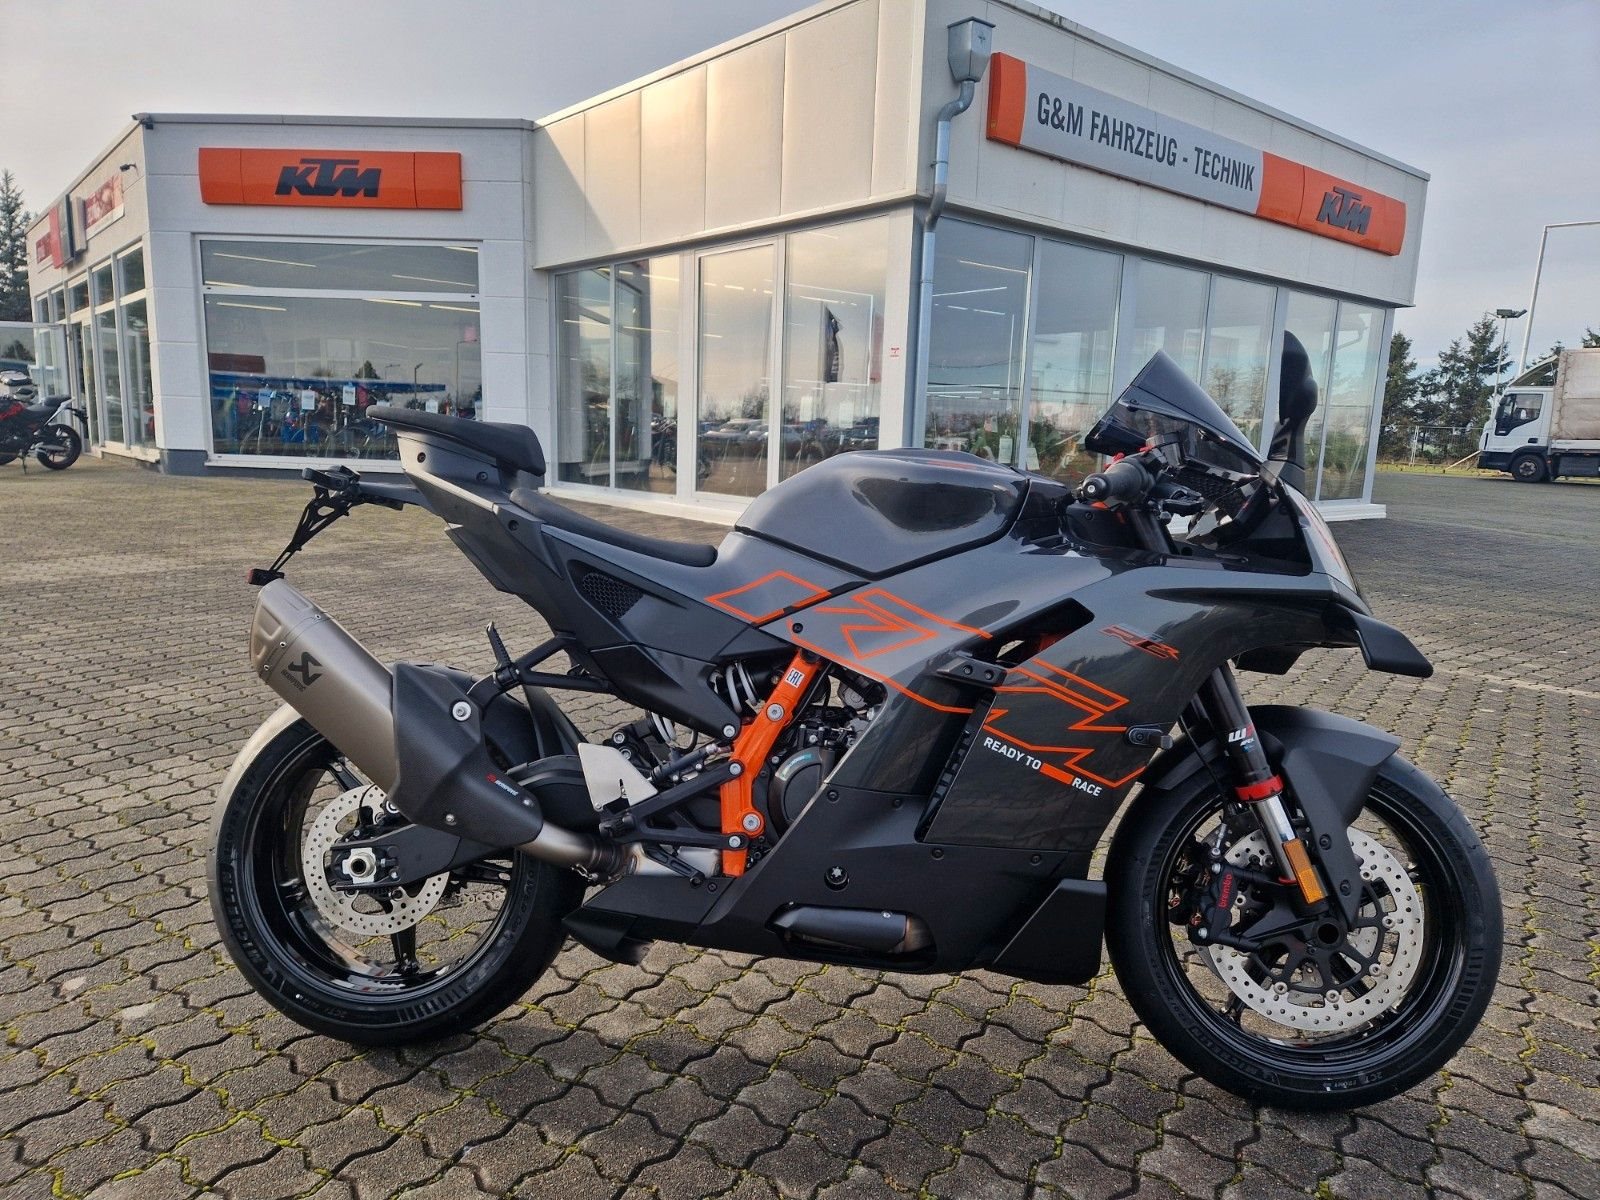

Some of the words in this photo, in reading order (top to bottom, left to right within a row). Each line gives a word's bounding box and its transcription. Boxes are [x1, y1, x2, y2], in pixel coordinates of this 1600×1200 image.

[1037, 92, 1084, 137] G&M
[1089, 111, 1178, 167] FAHRZEUG
[1181, 155, 1189, 165] -
[1194, 146, 1256, 191] TECHNIK
[274, 158, 382, 198] KTM
[1315, 186, 1373, 236] KTM
[983, 736, 1025, 764] READY
[1025, 754, 1042, 771] TO
[1071, 777, 1103, 798] RACE
